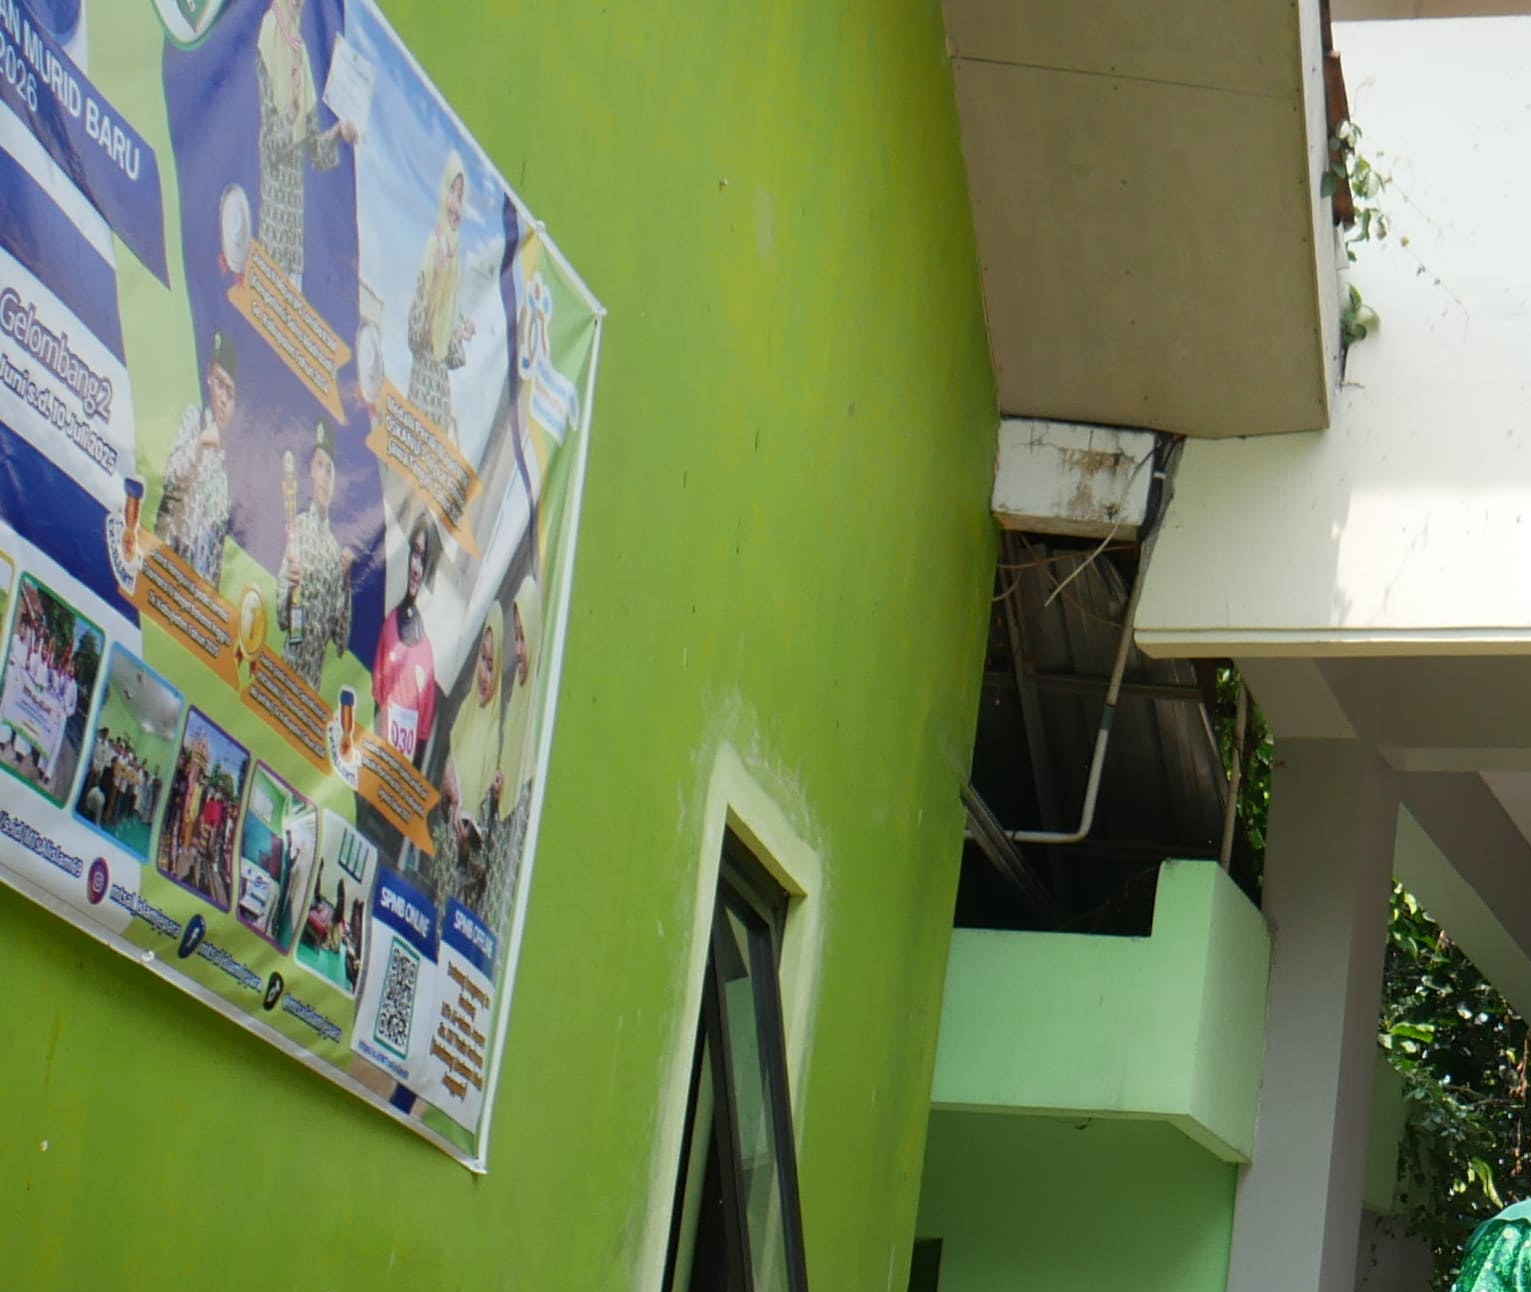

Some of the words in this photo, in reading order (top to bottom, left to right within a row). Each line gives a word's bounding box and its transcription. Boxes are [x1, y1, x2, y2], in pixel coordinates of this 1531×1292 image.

[24, 19, 81, 118] MURID
[86, 97, 140, 181] BARU
[0, 289, 98, 418] Gelombang
[96, 376, 113, 424] 2
[51, 396, 67, 430] 10
[65, 412, 89, 451] Juli
[87, 431, 118, 476] 2025
[380, 886, 406, 920] SPMB
